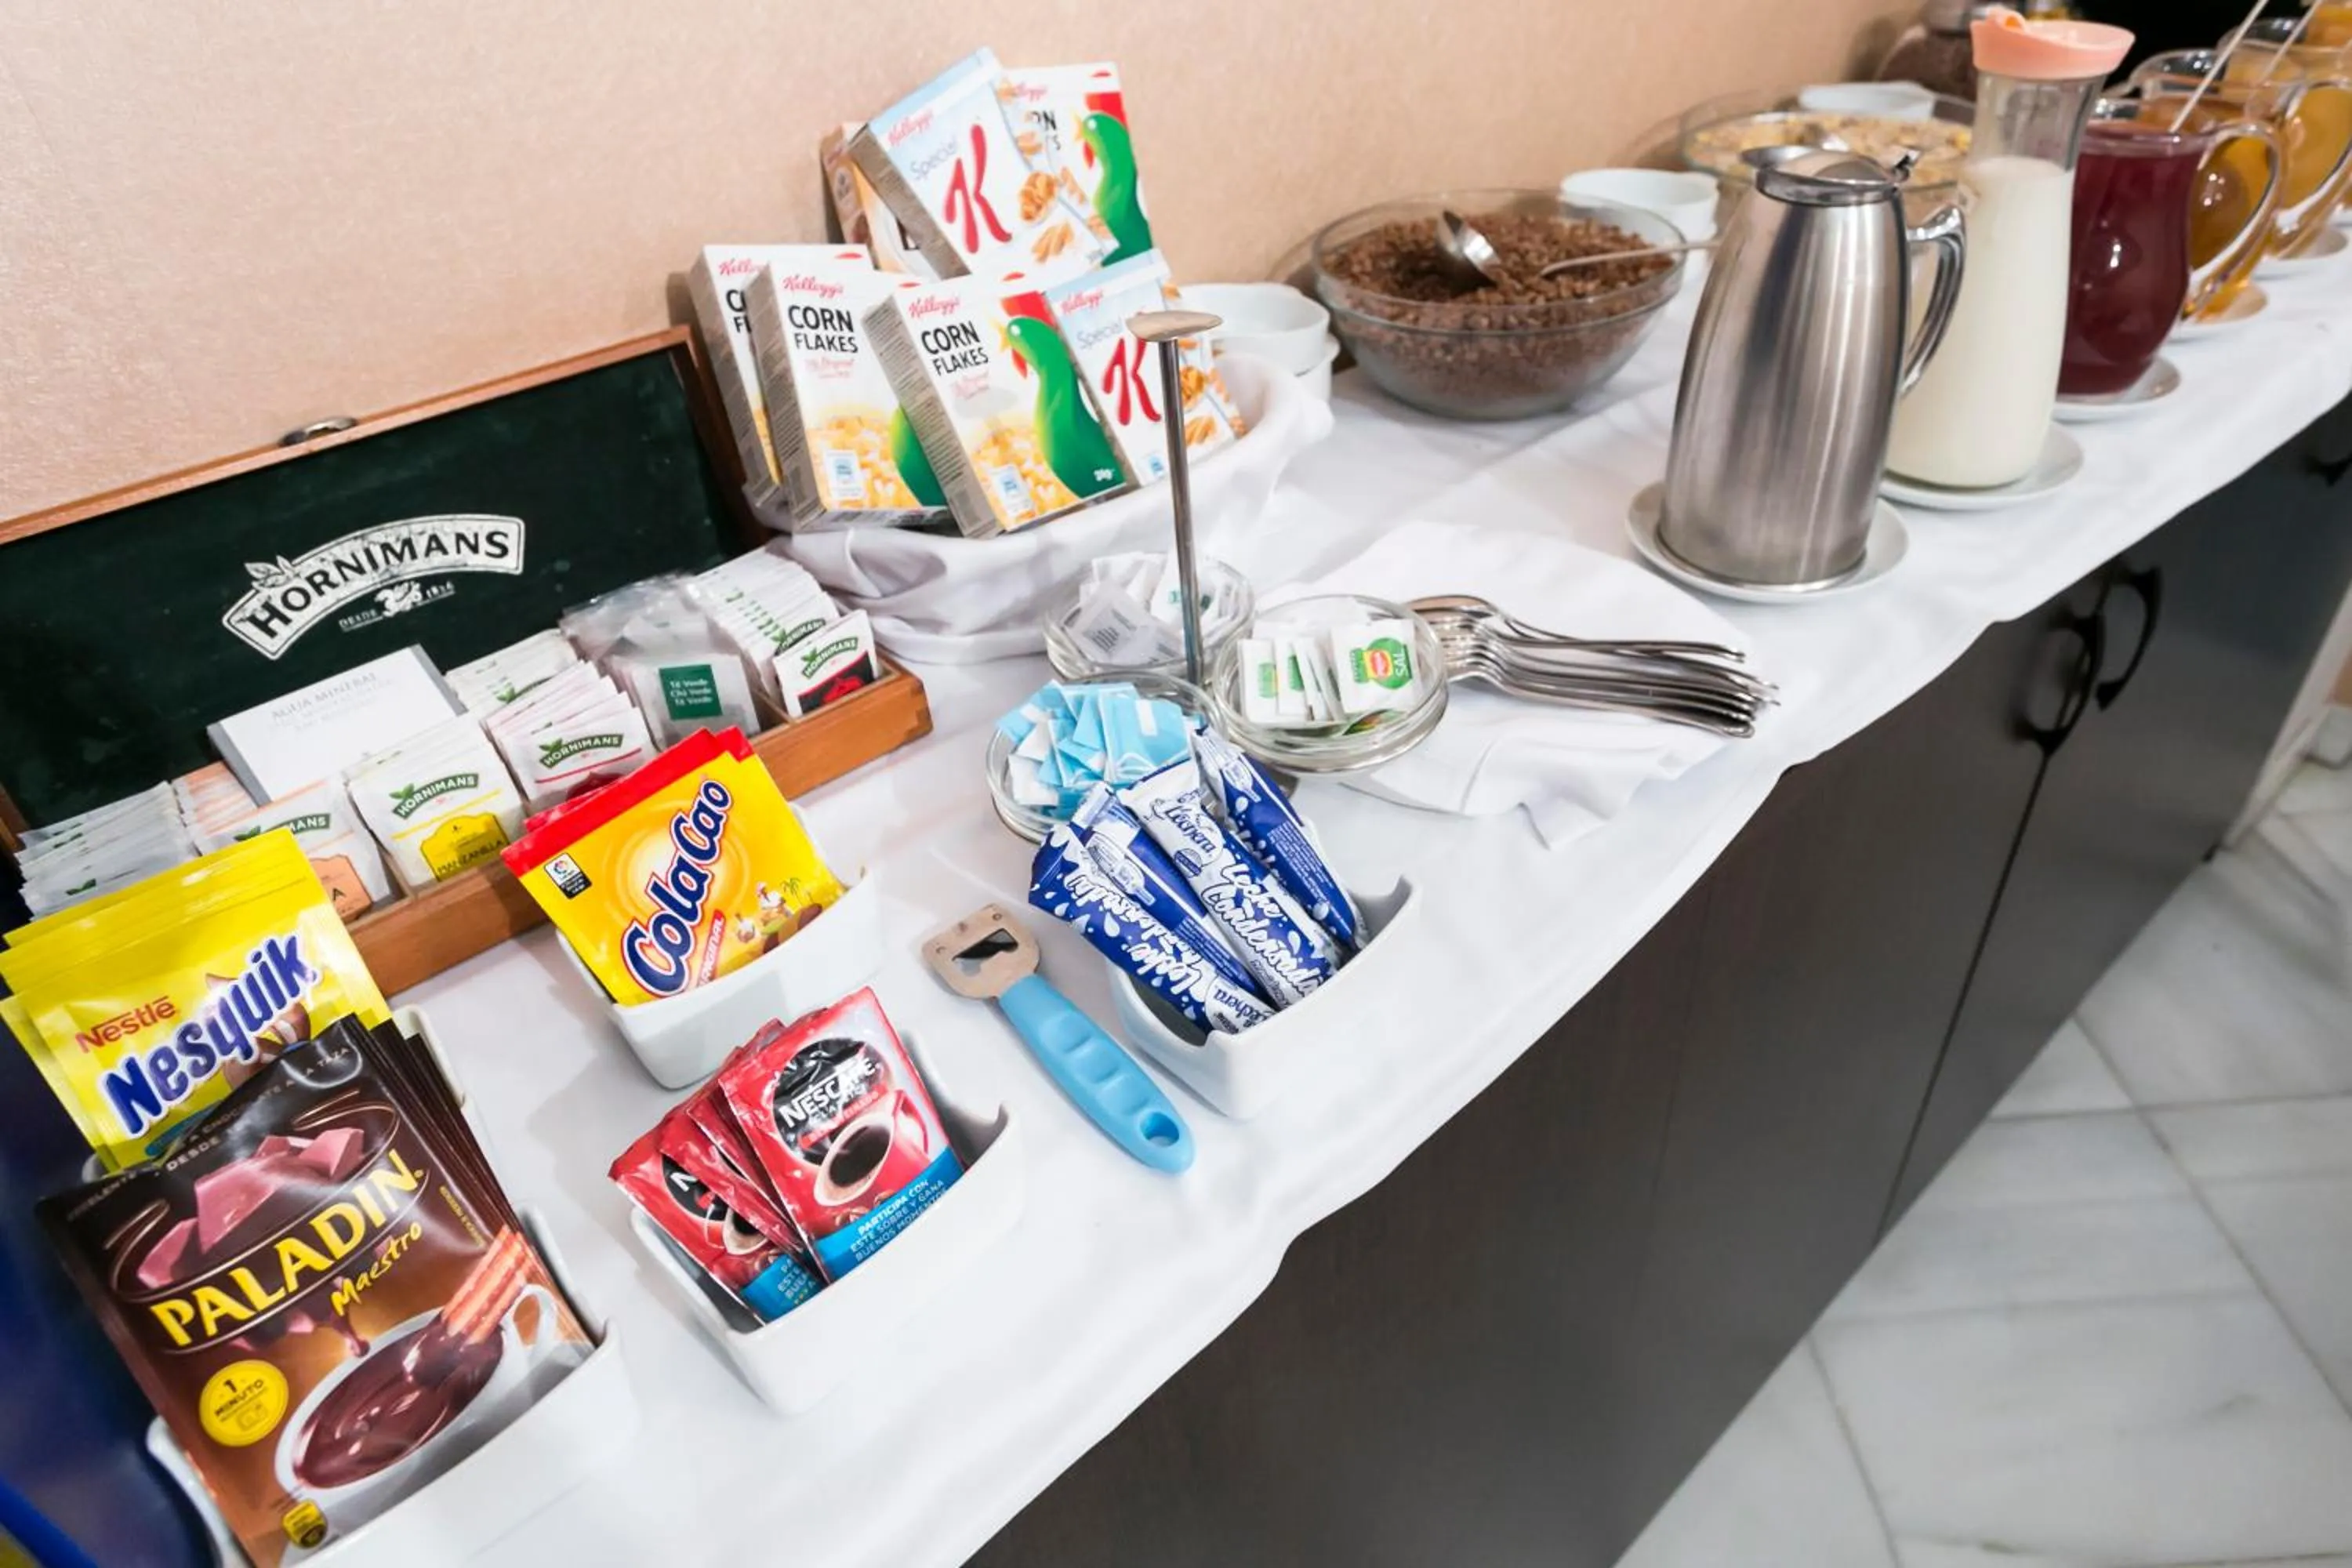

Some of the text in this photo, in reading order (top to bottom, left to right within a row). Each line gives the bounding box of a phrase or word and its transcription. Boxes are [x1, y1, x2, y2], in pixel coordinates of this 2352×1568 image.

[944, 124, 1013, 254] K
[788, 304, 855, 333] CORN
[921, 320, 981, 354] CORN
[794, 332, 859, 354] FLAKES
[932, 347, 989, 376] FLAKES
[1102, 311, 1162, 426] K
[247, 531, 511, 640] HORNIMANS
[1392, 648, 1408, 677] SAL
[543, 736, 619, 767] HORNIMANS
[397, 775, 475, 817] HORNIMANS
[1221, 863, 1283, 918] Leche
[103, 934, 318, 1134] Nesquik
[165, 1137, 221, 1172] DESDE
[851, 1229, 875, 1252] ESTE
[877, 1206, 909, 1233] SOBRE
[918, 1180, 945, 1202] GANA
[858, 1179, 929, 1235] PARTICIPA CON
[150, 1148, 419, 1347] PALADIN
[855, 1227, 896, 1261] BUENOS
[330, 1221, 423, 1317] Maestro
[214, 1379, 264, 1417] MINUTO
[223, 1379, 238, 1393] 1
